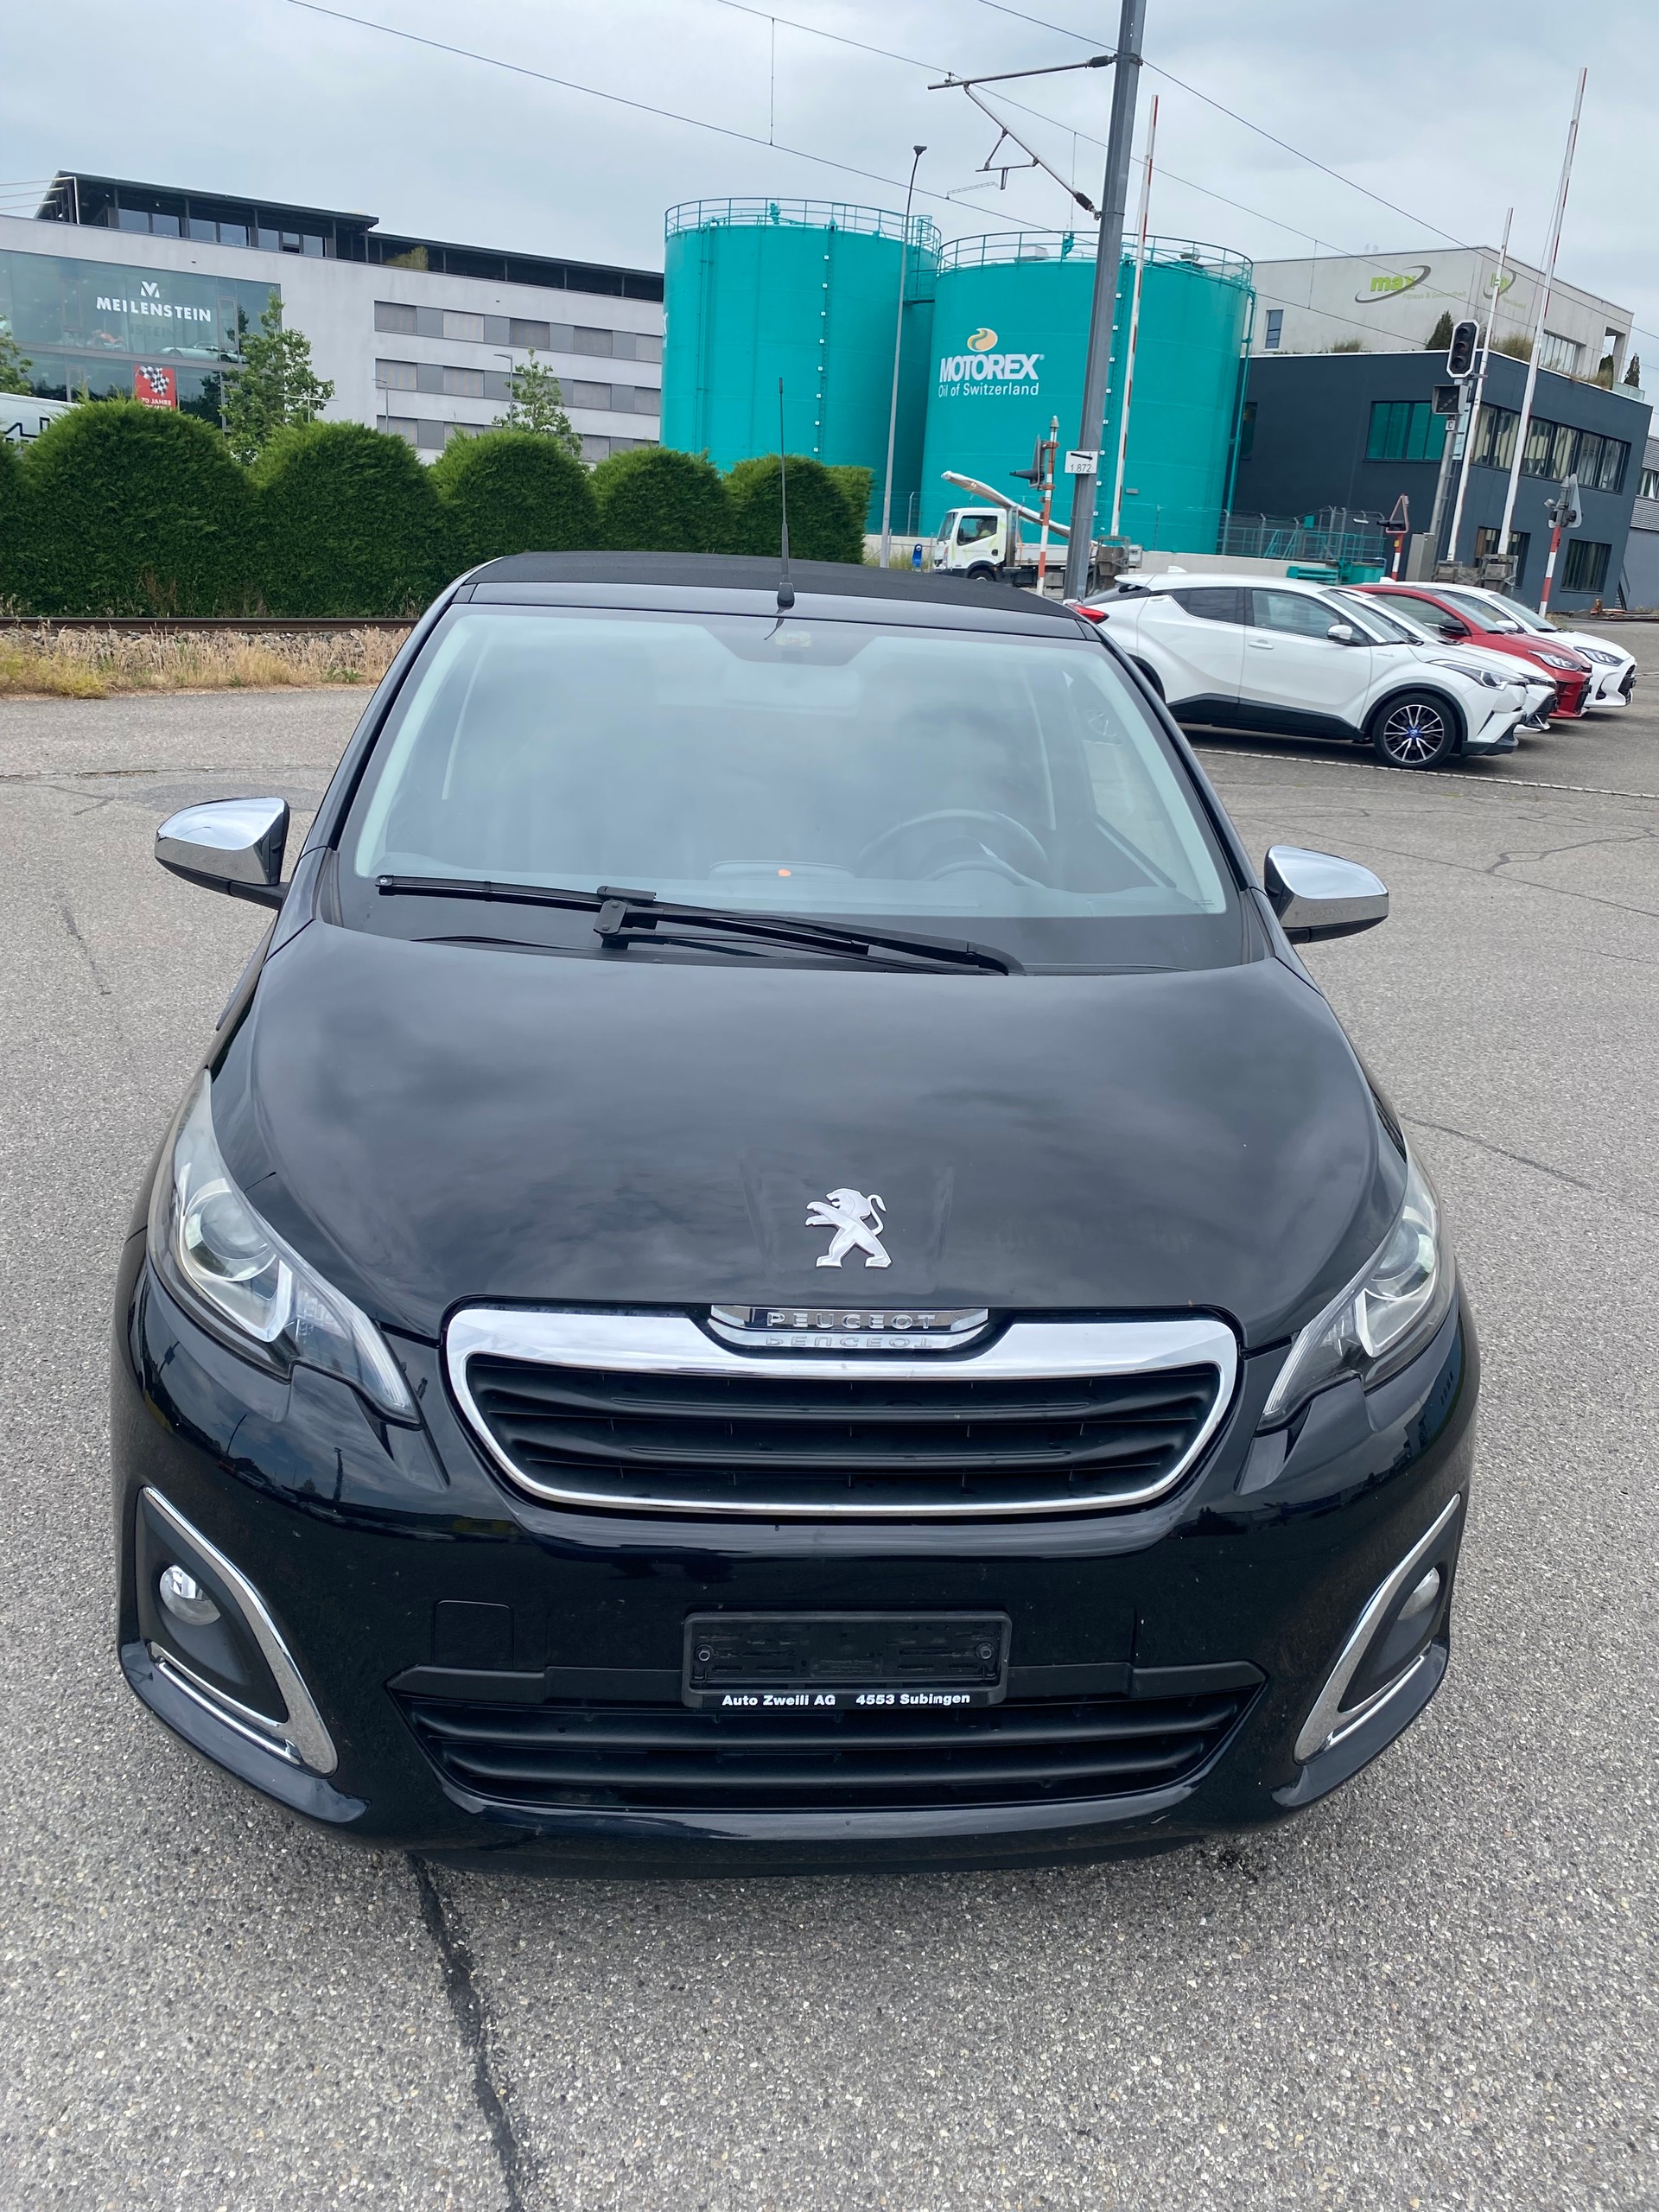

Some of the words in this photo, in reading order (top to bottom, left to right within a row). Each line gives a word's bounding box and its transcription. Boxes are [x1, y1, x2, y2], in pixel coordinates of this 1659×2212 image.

[1370, 275, 1417, 292] max
[96, 296, 211, 322] MEILENSTEIN
[939, 353, 1039, 382] MOTOREX
[938, 385, 948, 397] Oil
[950, 383, 961, 397] of
[963, 382, 1039, 396] Switzerland
[766, 1312, 936, 1329] PEUGEOT
[721, 1695, 758, 1707] Auto
[814, 1694, 836, 1706] AG
[855, 1694, 895, 1705] 4553
[899, 1694, 970, 1707] Subingen
